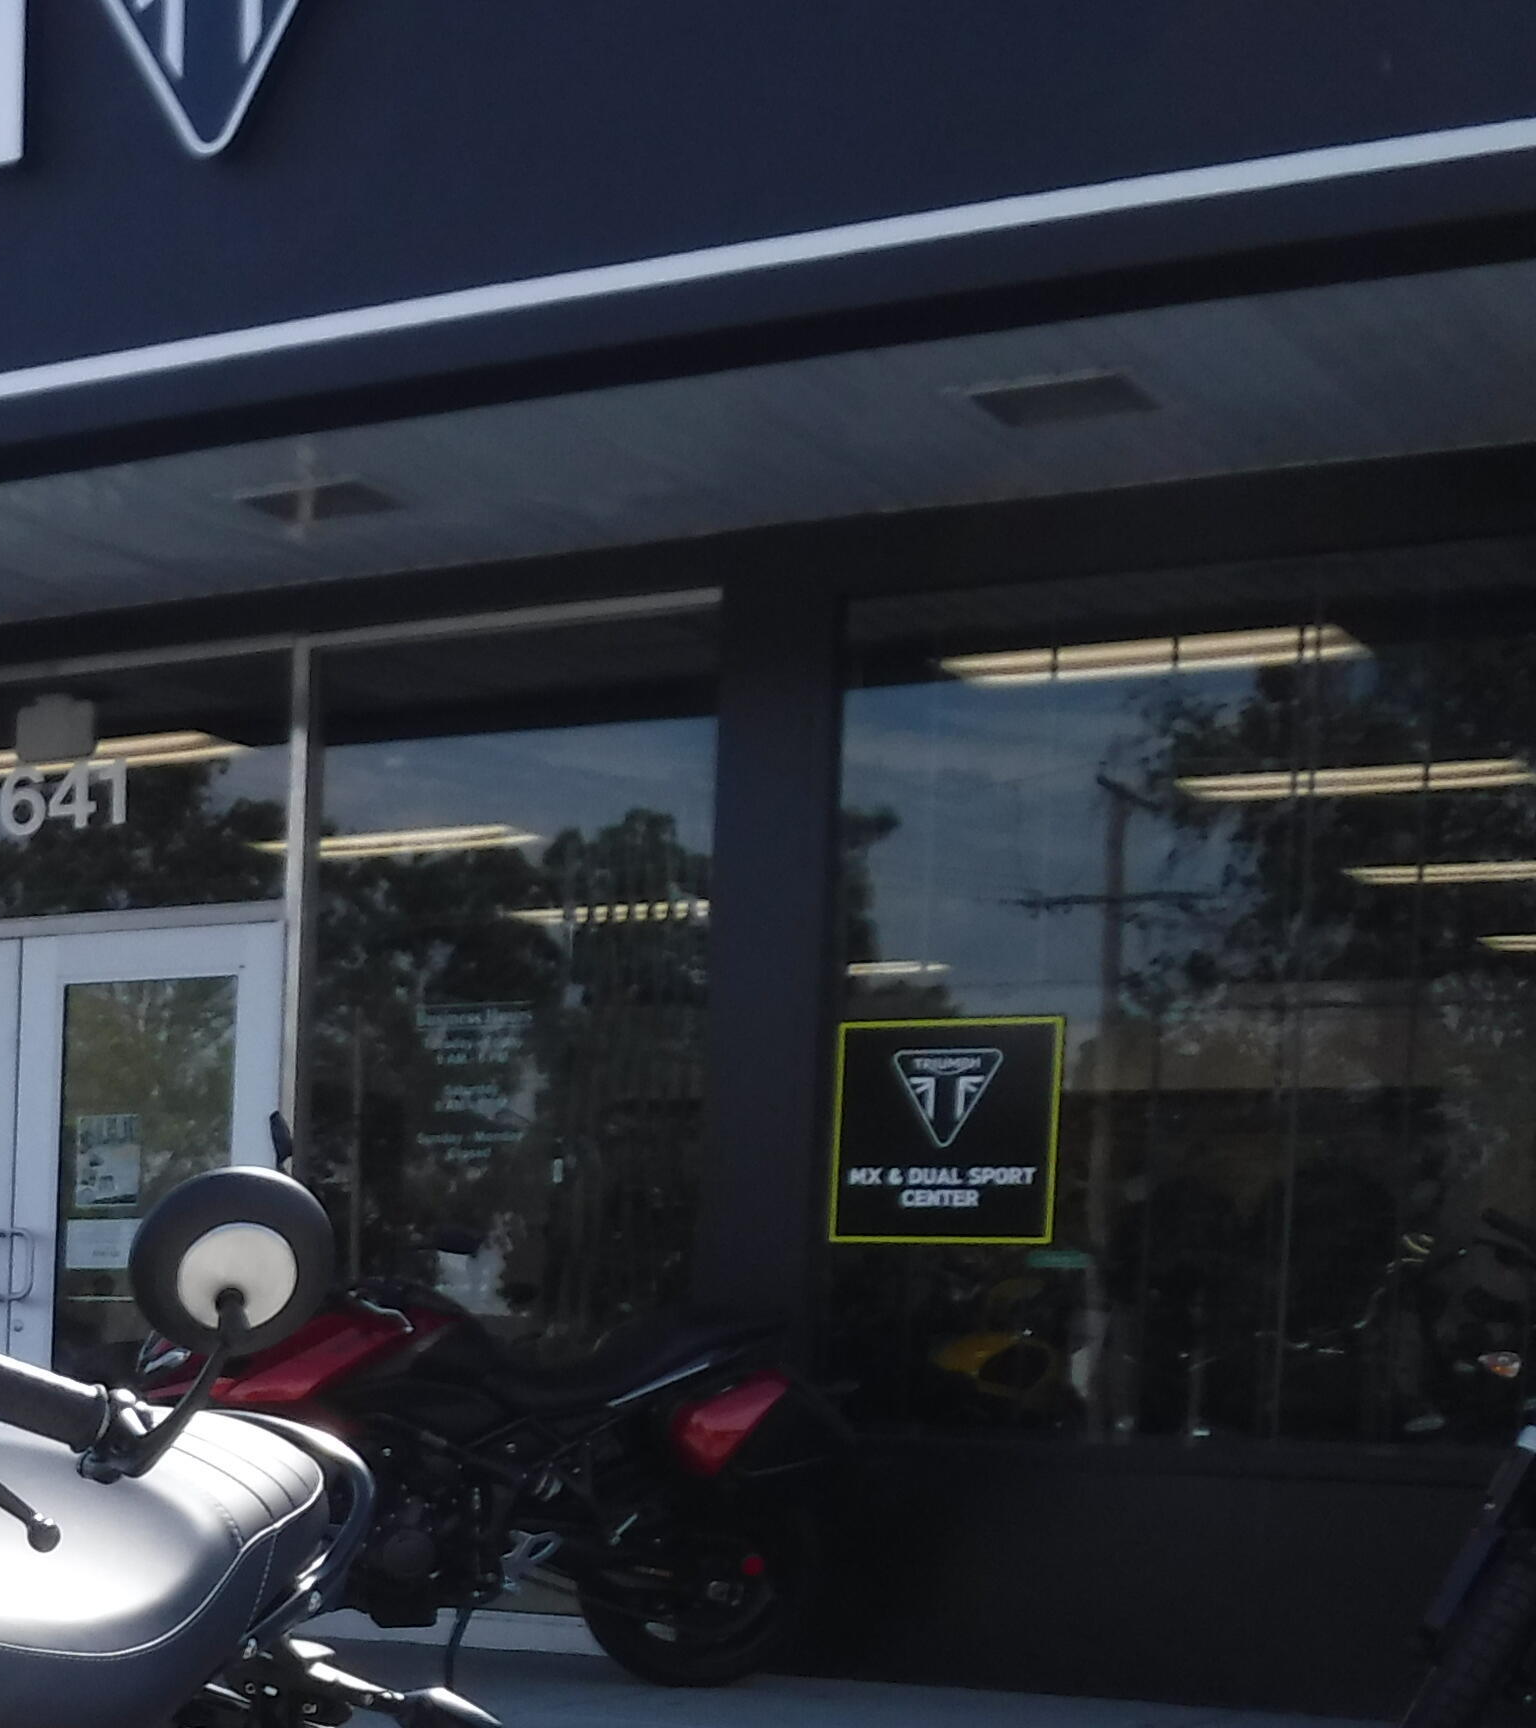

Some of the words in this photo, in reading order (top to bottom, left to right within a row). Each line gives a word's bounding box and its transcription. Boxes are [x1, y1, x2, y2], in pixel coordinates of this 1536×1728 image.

[912, 1057, 982, 1075] TRIUMPH
[848, 1167, 882, 1186] MX
[887, 1167, 904, 1186] &
[908, 1167, 963, 1186] DUAL
[968, 1166, 1037, 1186] SPORT
[900, 1189, 980, 1208] CENTER
